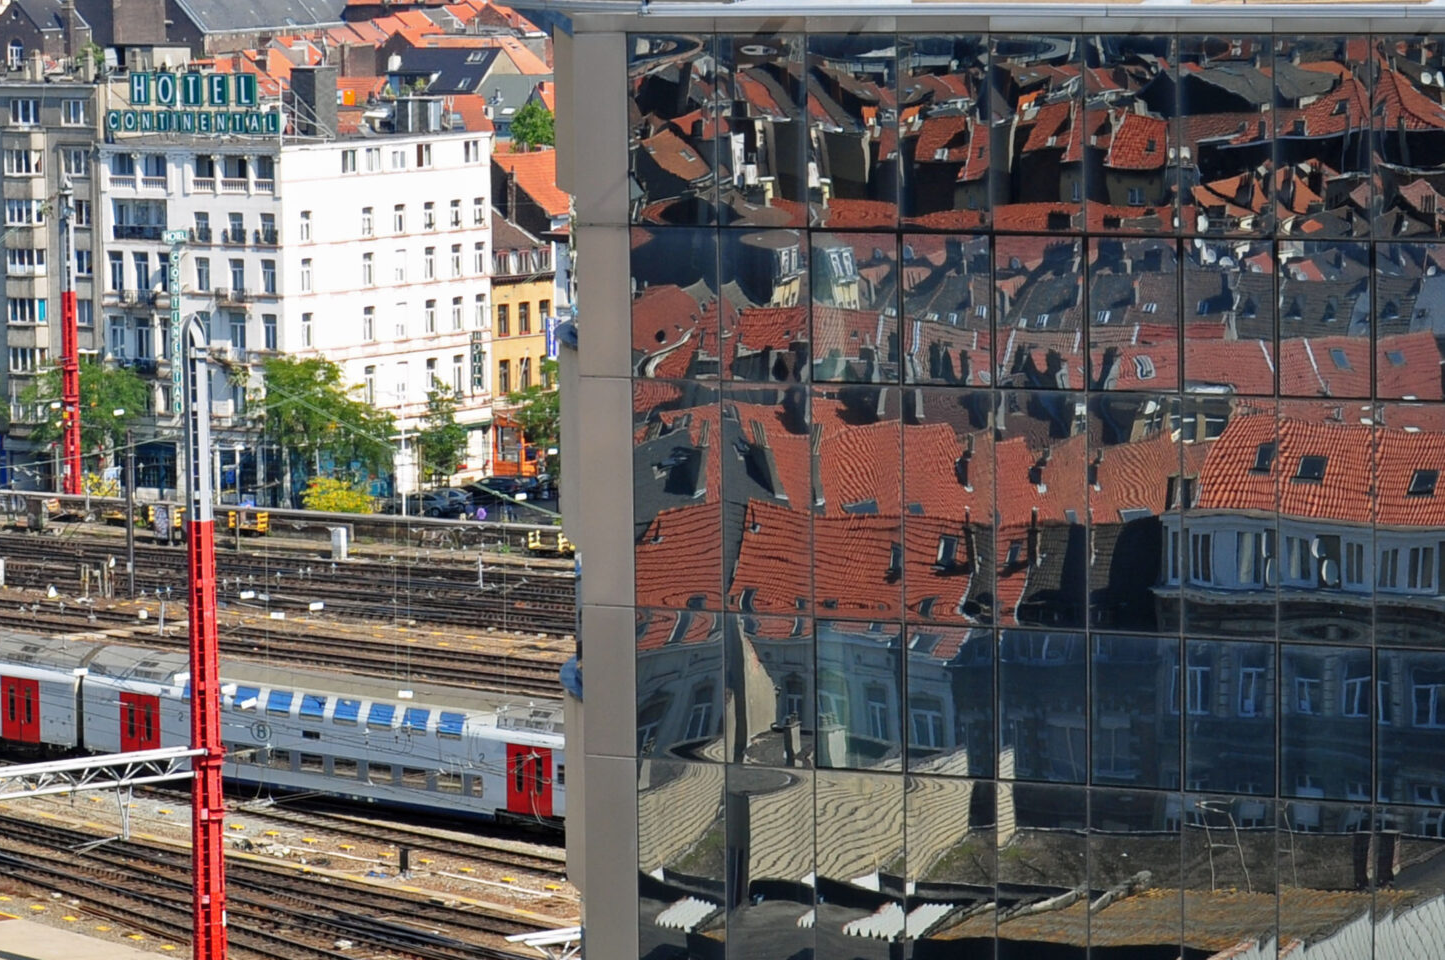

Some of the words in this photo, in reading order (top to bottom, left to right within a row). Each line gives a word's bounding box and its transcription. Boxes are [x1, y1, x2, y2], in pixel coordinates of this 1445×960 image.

[132, 75, 251, 104] HOTEL
[108, 112, 276, 134] CONTINENTAL
[163, 231, 186, 241] HOTEL
[172, 252, 182, 412] CONTINENTAL
